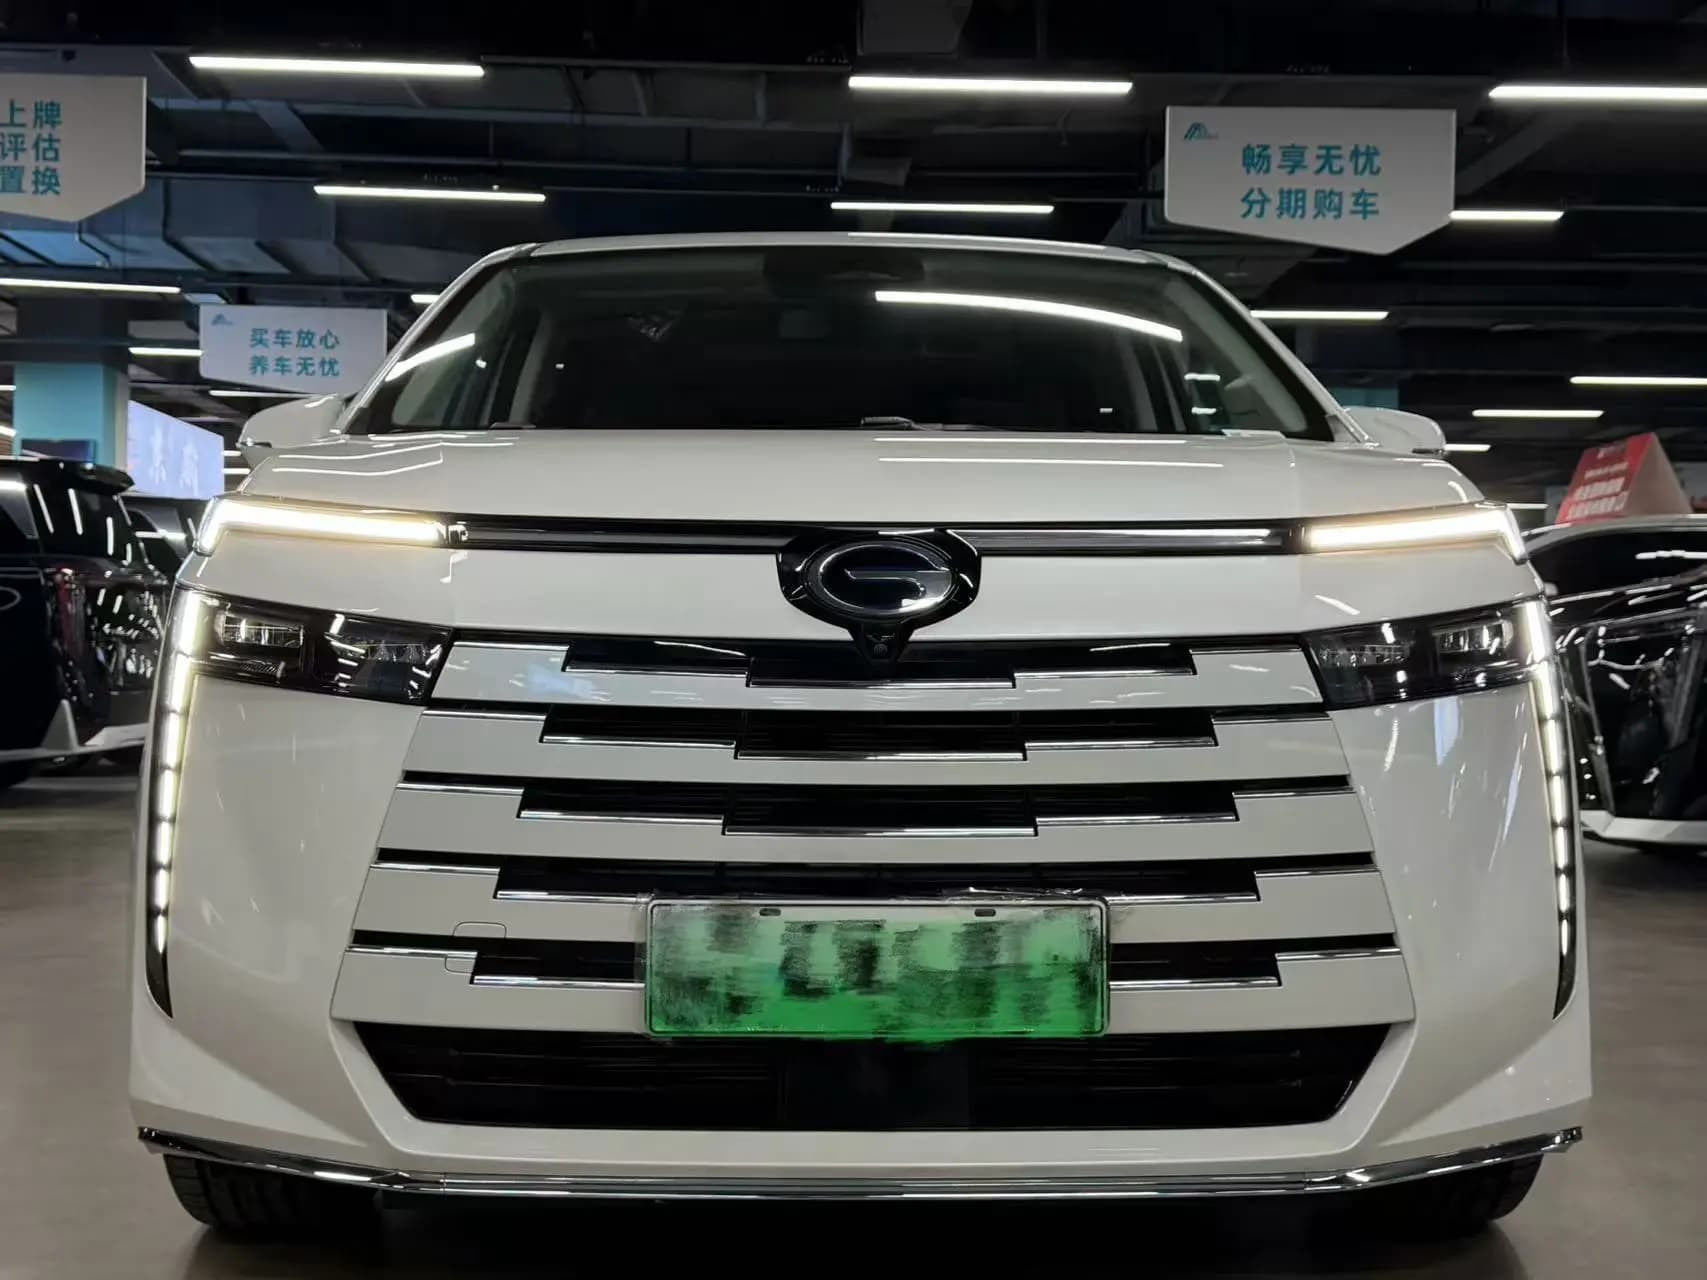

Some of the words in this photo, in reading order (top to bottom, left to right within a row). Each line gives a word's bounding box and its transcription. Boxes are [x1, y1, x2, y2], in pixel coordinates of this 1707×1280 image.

[0, 100, 63, 129] 上牌
[0, 132, 62, 162] 评估
[1242, 143, 1380, 176] 畅享无忧
[1240, 187, 1380, 219] 分期购车
[250, 328, 340, 349] 买车放心
[250, 356, 340, 376] 养车无忧
